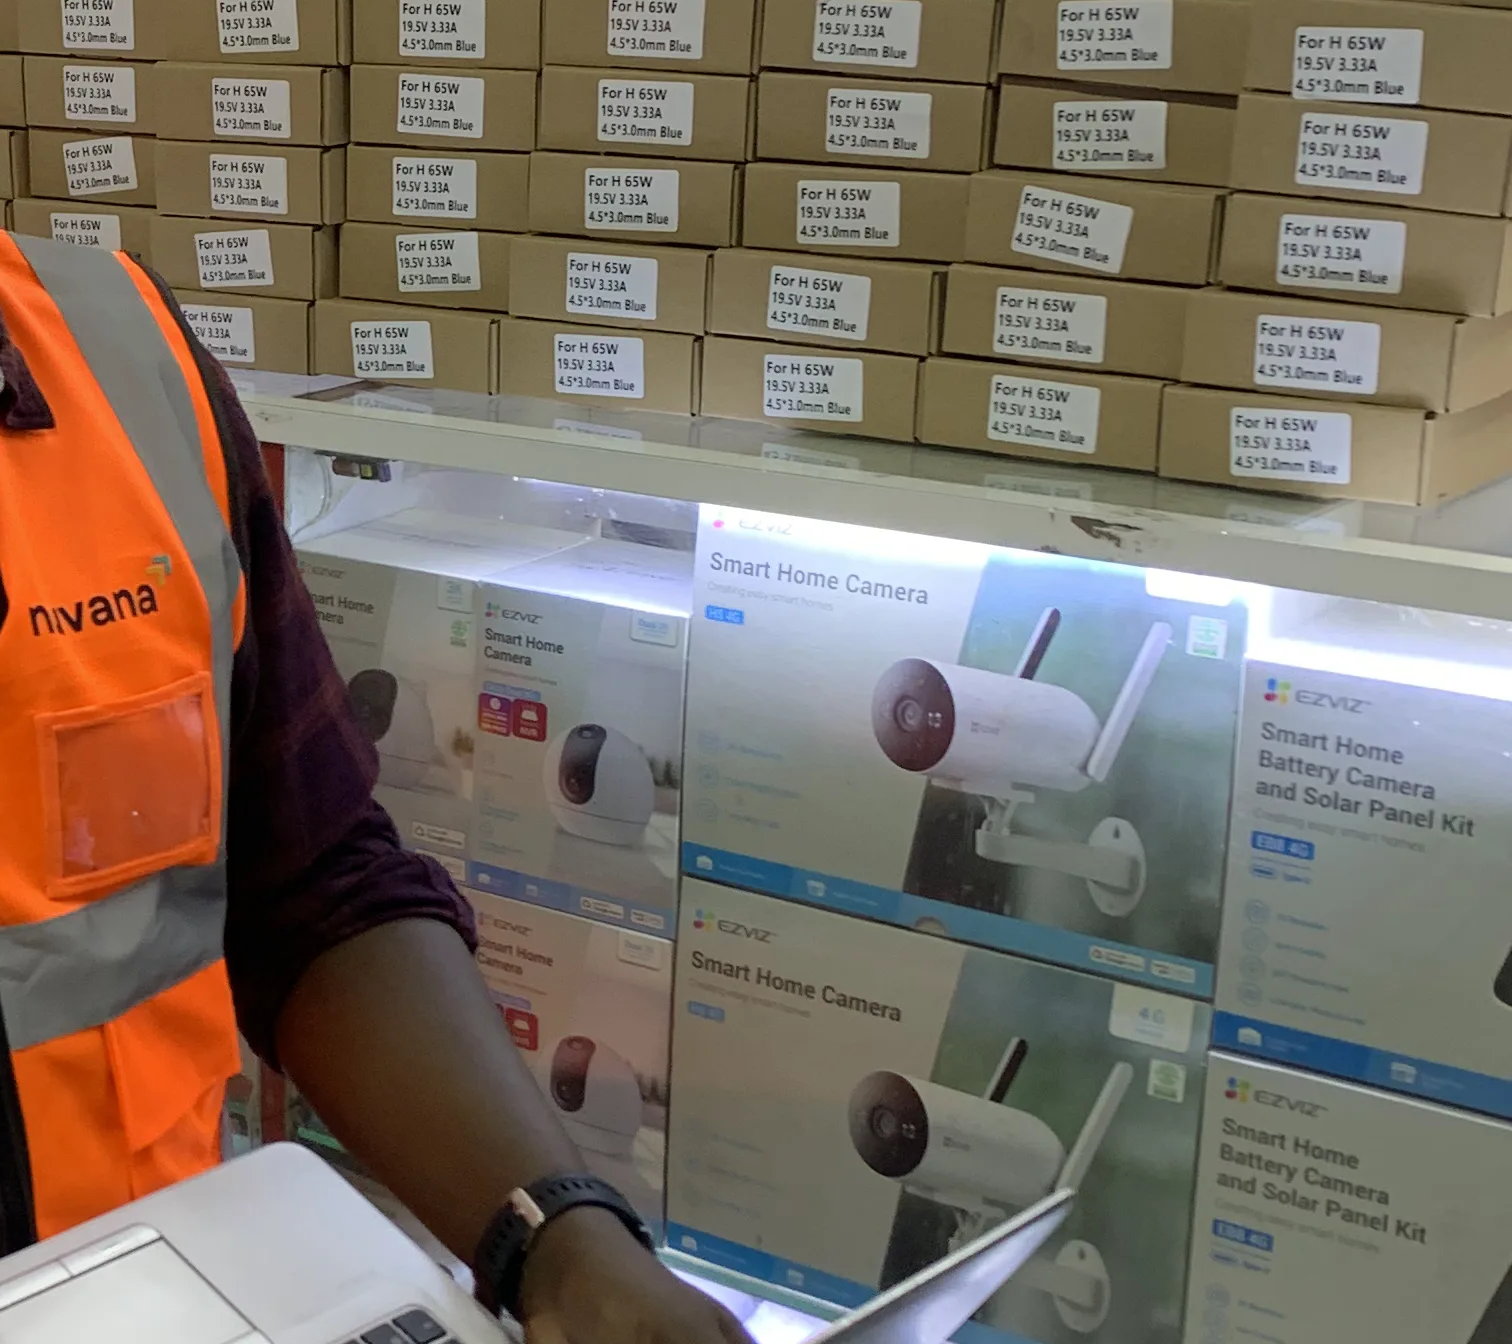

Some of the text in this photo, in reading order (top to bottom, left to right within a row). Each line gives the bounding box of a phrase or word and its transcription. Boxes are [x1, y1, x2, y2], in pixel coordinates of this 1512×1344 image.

[800, 187, 871, 201] For H 65W
[800, 206, 866, 219] 19.5V 3.33A
[863, 227, 889, 239] Blue
[1235, 414, 1317, 432] For H 65W
[1234, 435, 1312, 452] 19.5V 3.33A
[1309, 459, 1337, 475] Blue
[710, 552, 770, 579] Smart
[778, 563, 838, 590] Home
[845, 575, 929, 605] Camera
[502, 608, 539, 624] EZVIZ
[485, 628, 564, 655] Smart Home
[484, 646, 532, 667] Camera
[1295, 689, 1364, 713] EZVIZ
[1261, 721, 1404, 765] Smart Home
[1259, 750, 1436, 801] Battery Camera
[1256, 780, 1296, 802] and
[1304, 787, 1362, 815] Solar
[1370, 799, 1434, 830] Panel
[1442, 814, 1475, 838] Kit
[718, 918, 772, 944] EZVIZ
[691, 951, 902, 1024] Smart Home Camera
